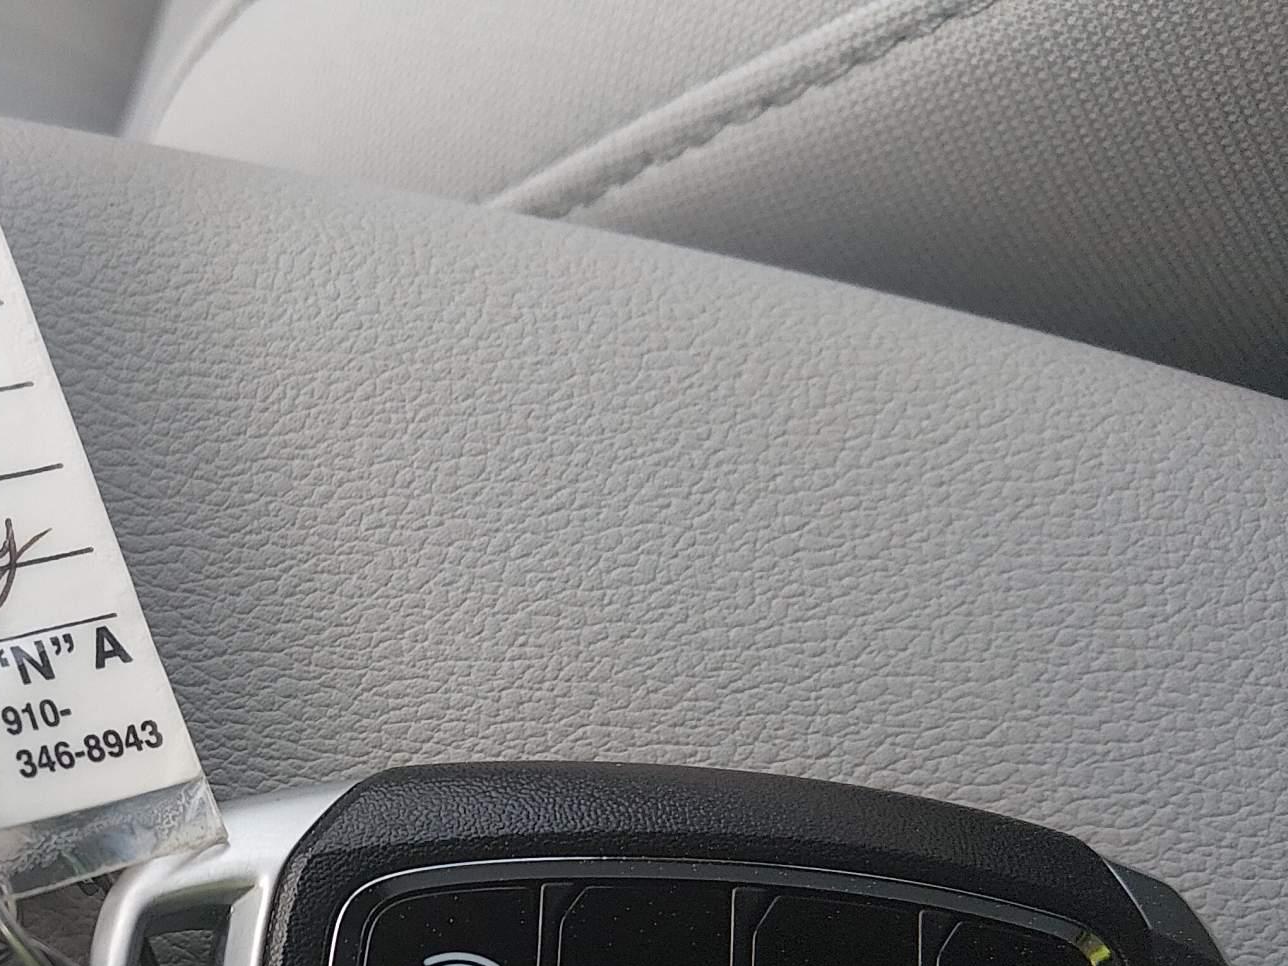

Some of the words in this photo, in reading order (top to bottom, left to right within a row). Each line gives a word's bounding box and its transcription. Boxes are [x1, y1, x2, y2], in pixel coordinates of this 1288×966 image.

[93, 625, 133, 671] A
[2, 700, 72, 735] 910-
[16, 720, 163, 778] 346-8943
